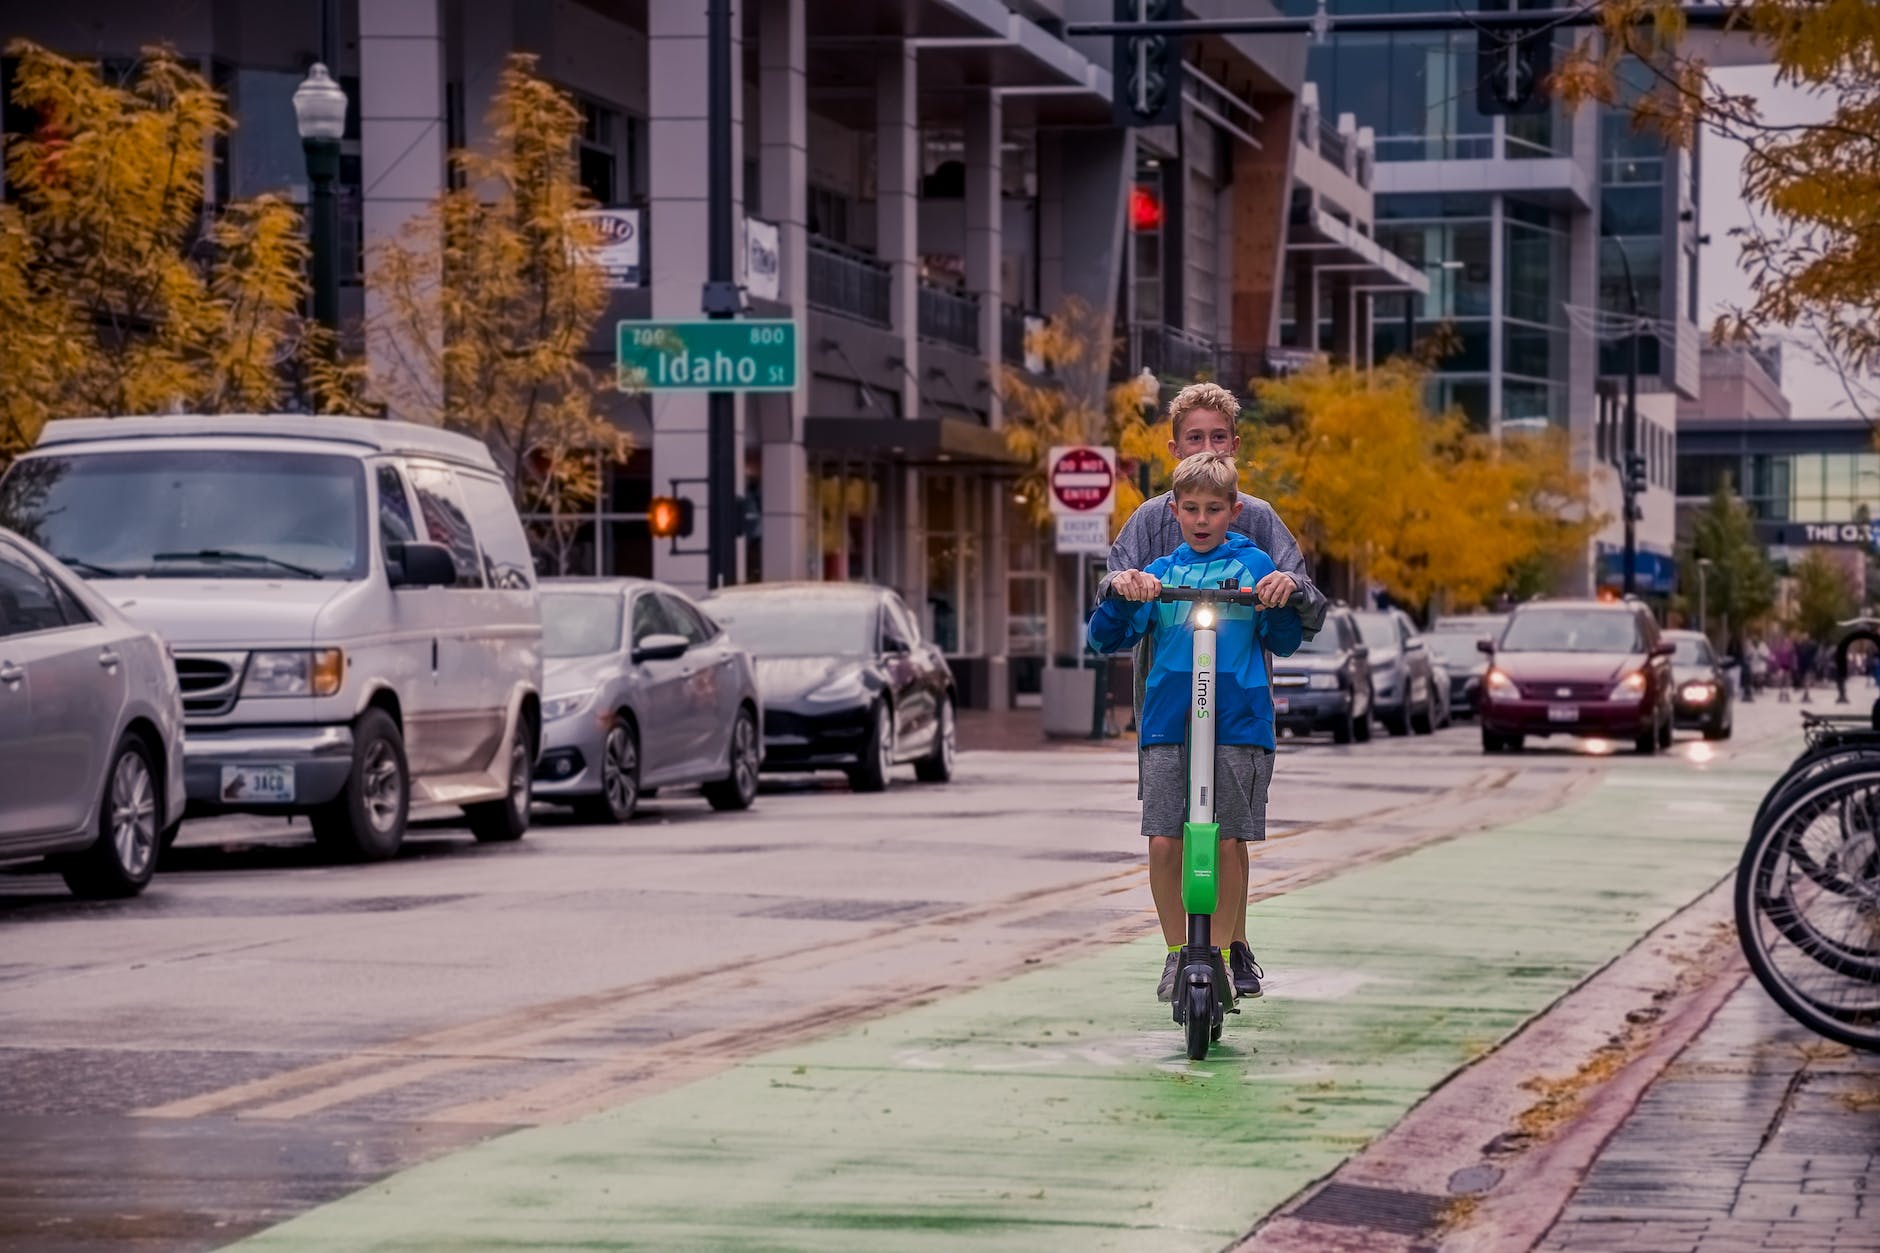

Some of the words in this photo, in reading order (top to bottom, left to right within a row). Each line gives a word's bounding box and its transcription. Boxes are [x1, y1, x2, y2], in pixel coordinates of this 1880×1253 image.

[750, 327, 785, 344] 800
[658, 350, 757, 383] Idaho
[768, 366, 784, 382] St
[1059, 460, 1077, 471] DO
[1081, 460, 1104, 471] NOT
[1063, 489, 1100, 500] ENTER
[1063, 520, 1100, 531] EXCEPT
[1806, 524, 1839, 541] THE
